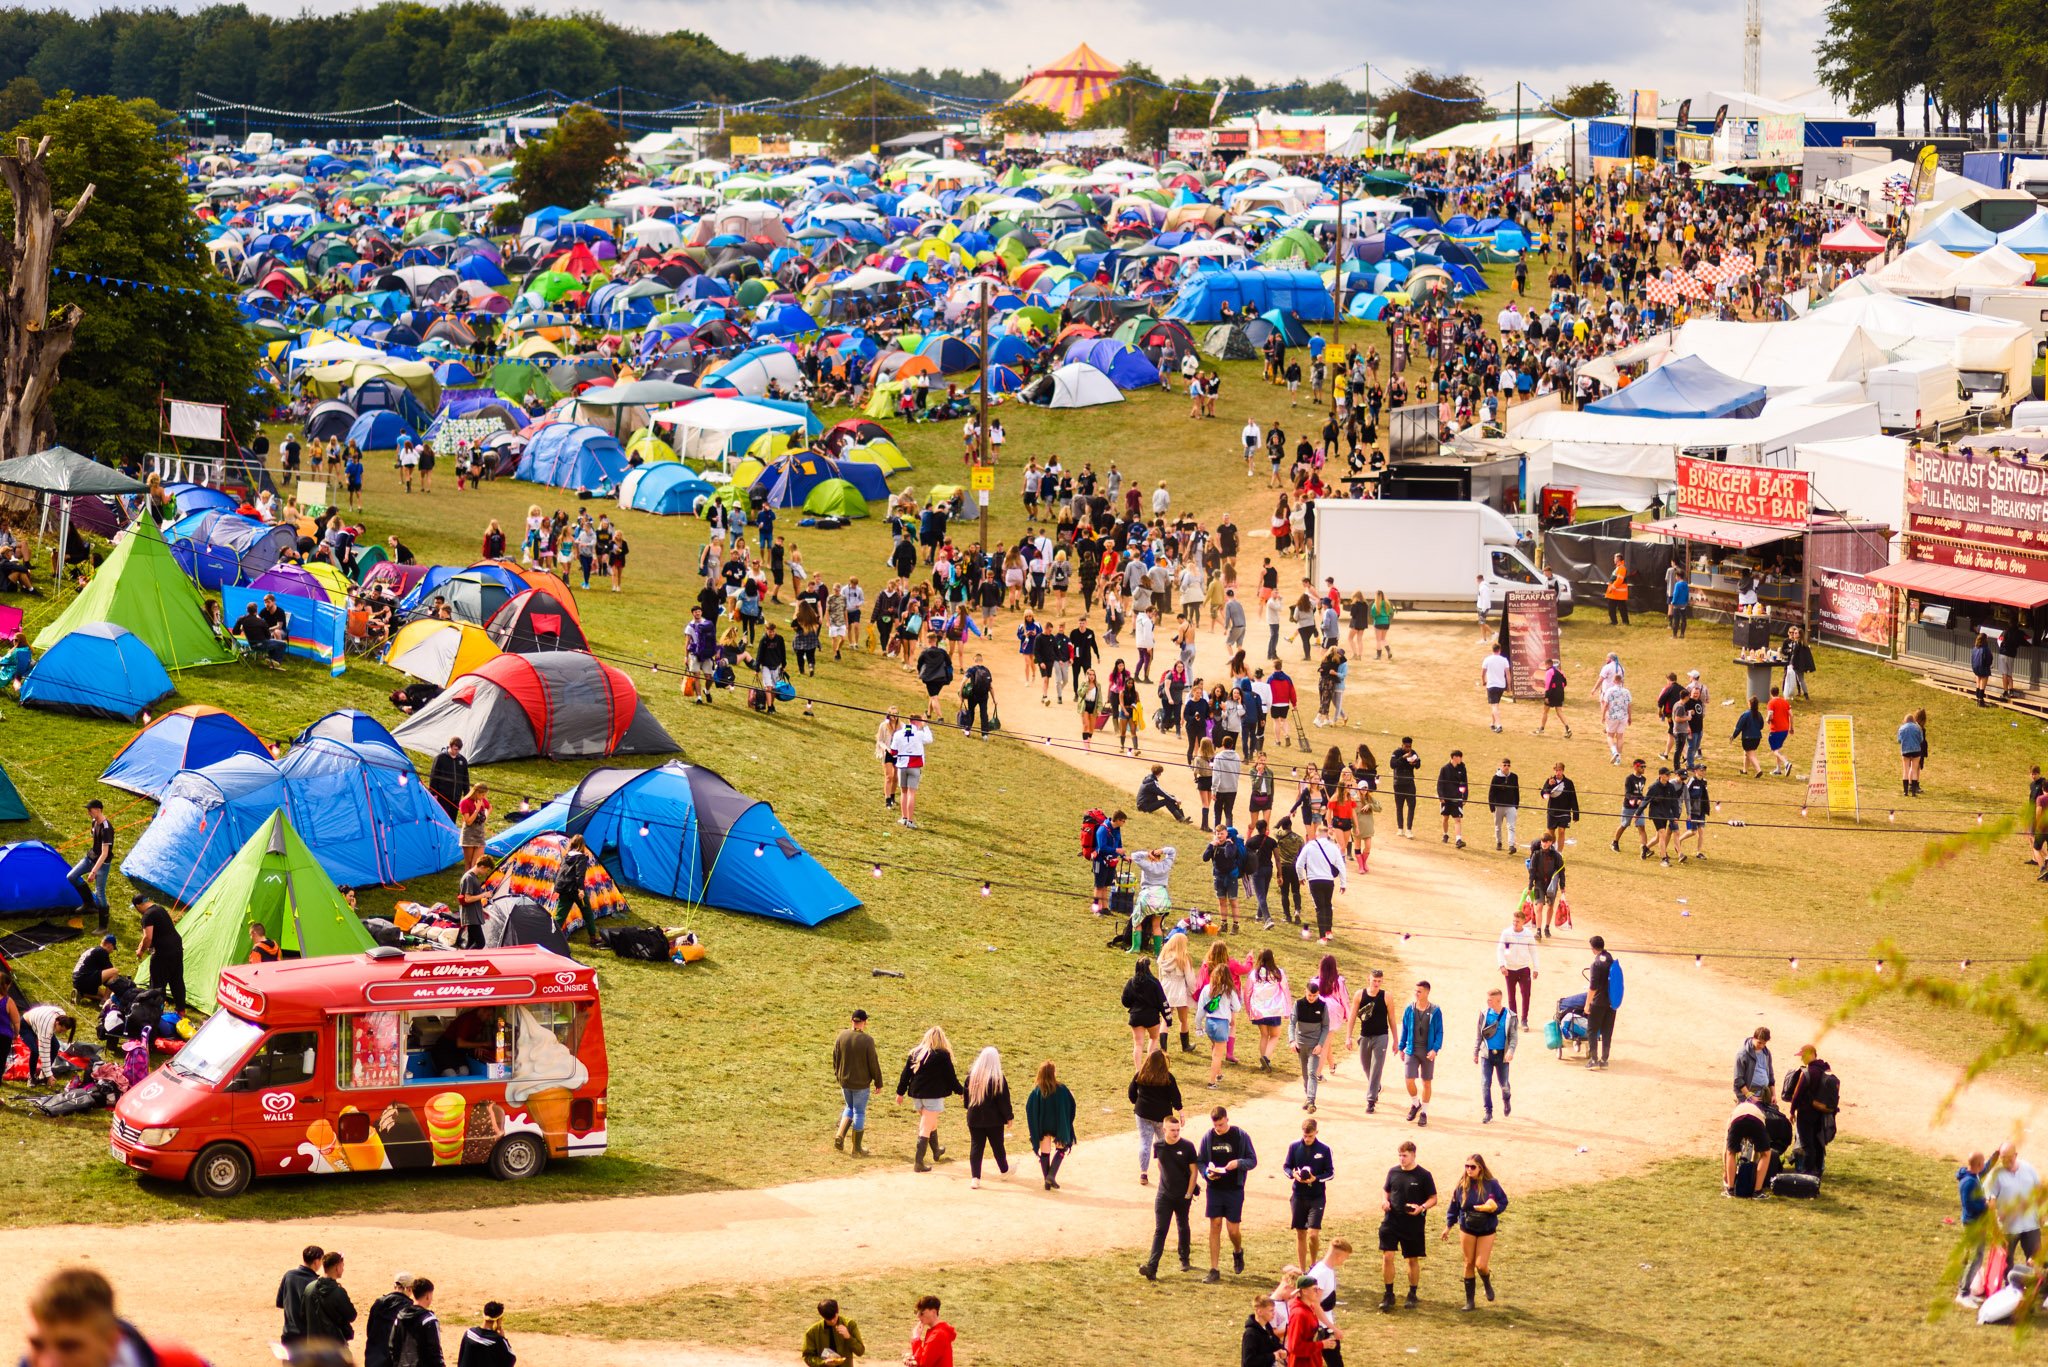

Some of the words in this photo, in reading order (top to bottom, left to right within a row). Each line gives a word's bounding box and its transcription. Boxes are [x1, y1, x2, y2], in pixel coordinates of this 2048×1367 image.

[1688, 467, 1751, 494] BURGER
[1758, 477, 1795, 499] BAR
[1915, 452, 1986, 489] BREAKFAST
[1987, 460, 2040, 495] SERVED
[1678, 485, 1768, 516] BREAKFAST
[1771, 498, 1807, 520] BAR
[1921, 486, 1942, 508] FULL
[1943, 489, 1980, 513] ENGLISH
[1991, 495, 2041, 521] BREAKFAST
[2017, 530, 2033, 542] coffee
[1954, 549, 1973, 565] Fresh
[1974, 552, 1993, 569] From
[1994, 557, 2008, 571] Our
[2009, 559, 2027, 574] Oven
[1821, 574, 1839, 590] HOME
[1840, 578, 1866, 596] COOKED
[1509, 593, 1555, 601] BREAKFAST
[410, 968, 431, 977] Mr.
[432, 964, 490, 977] Whippy
[226, 982, 255, 1009] Whippy
[413, 989, 435, 997] Mr.
[436, 985, 496, 997] Whippy
[542, 985, 563, 993] COOL
[564, 983, 588, 992] INSIDE
[263, 1113, 294, 1122] WALL'S
